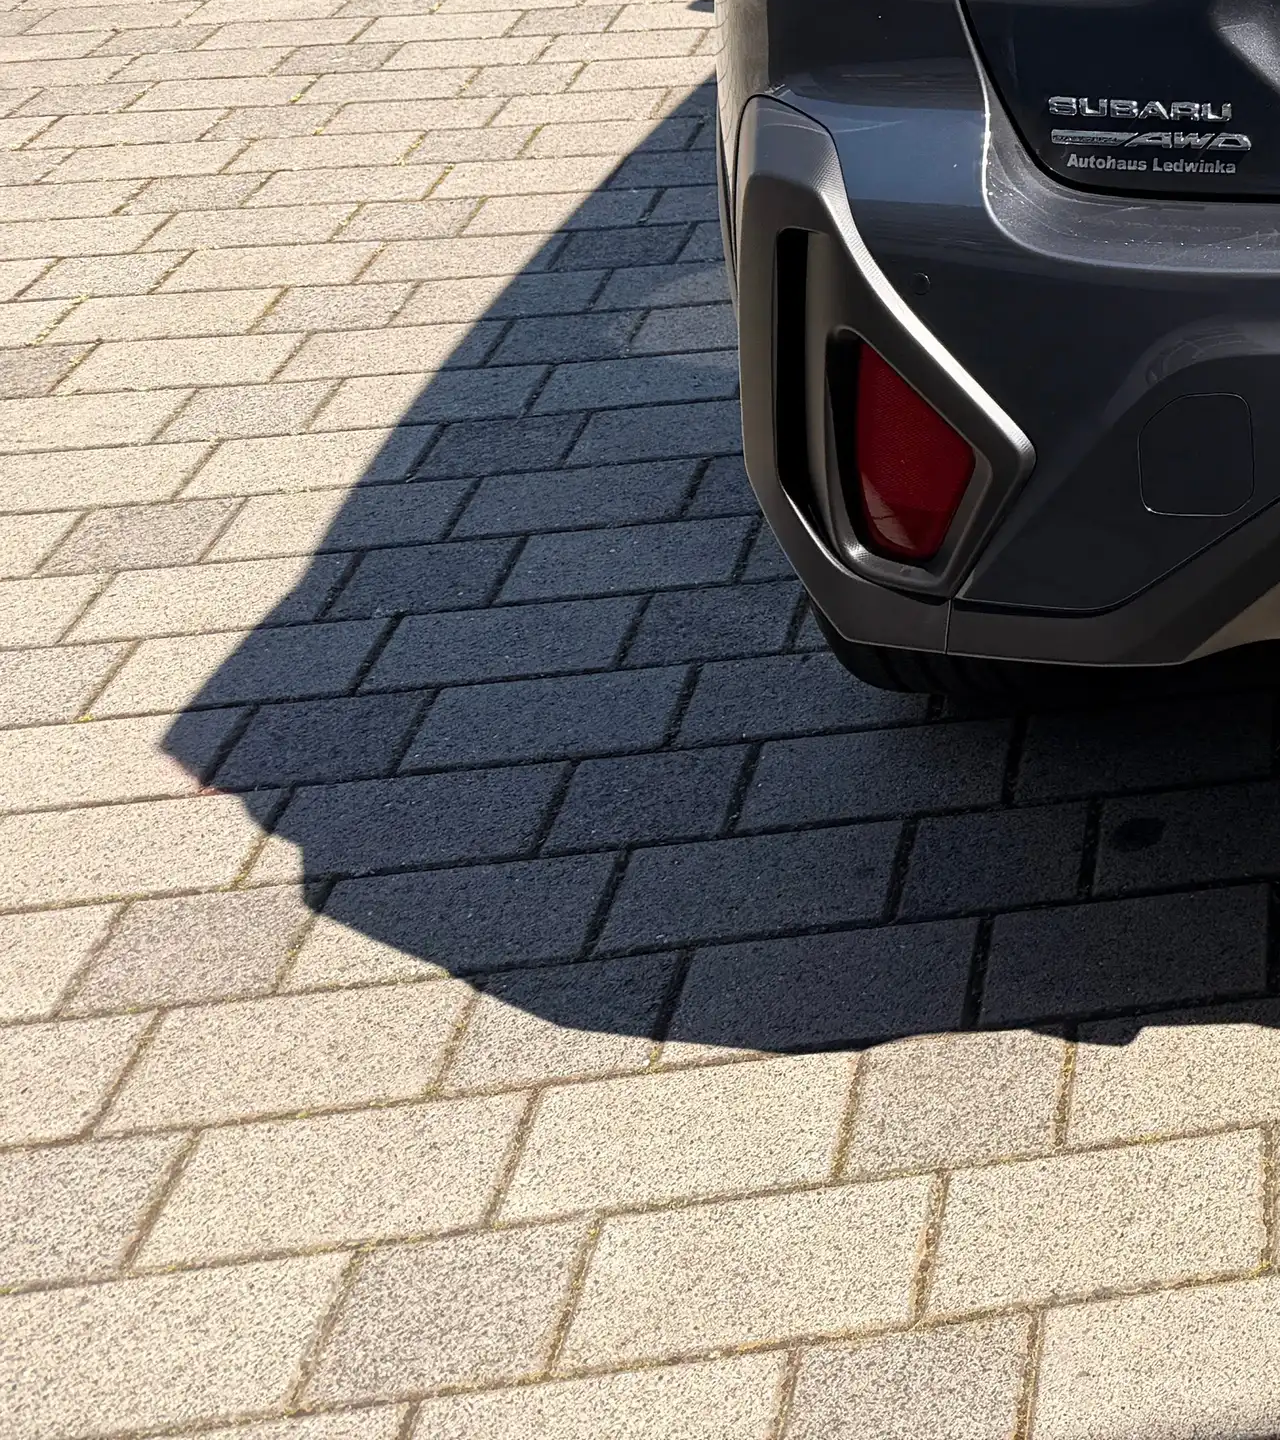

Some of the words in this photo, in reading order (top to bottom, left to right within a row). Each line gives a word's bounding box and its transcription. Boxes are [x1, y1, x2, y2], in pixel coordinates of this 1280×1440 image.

[1047, 95, 1233, 122] SUBARU
[1124, 130, 1252, 151] AWD
[1066, 153, 1148, 172] Autohaus
[1152, 157, 1237, 174] Ledwinka
